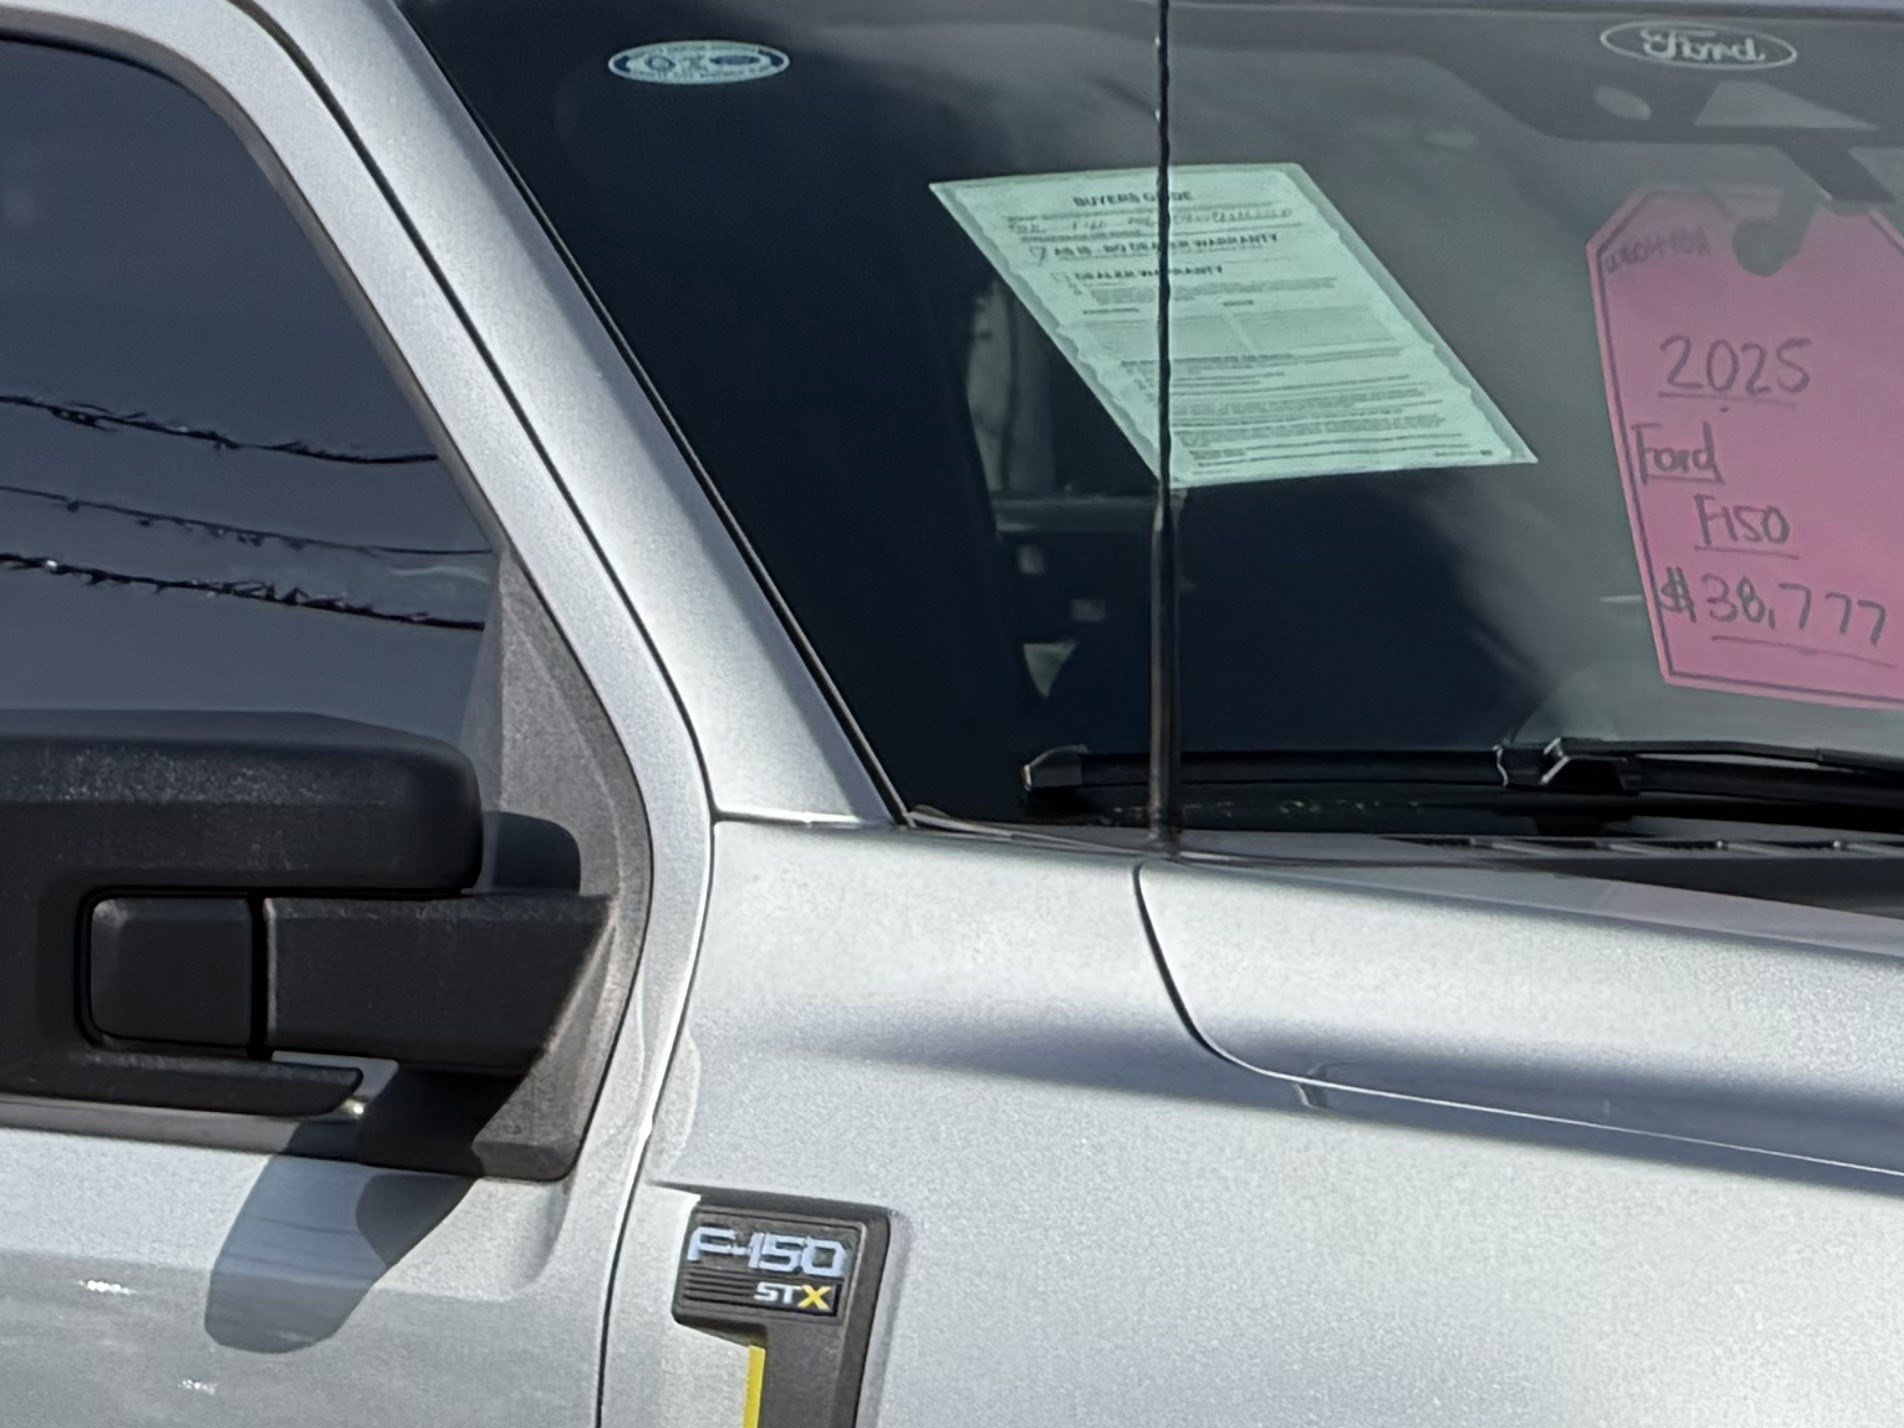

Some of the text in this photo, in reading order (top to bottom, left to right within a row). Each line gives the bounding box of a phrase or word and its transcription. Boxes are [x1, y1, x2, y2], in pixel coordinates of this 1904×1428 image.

[1639, 28, 1766, 62] Ford
[1659, 334, 1812, 395] 2025
[1631, 421, 1726, 485] Ford
[1659, 566, 1887, 645] $38,777
[686, 1225, 848, 1278] F-150
[752, 1280, 832, 1311] STX
